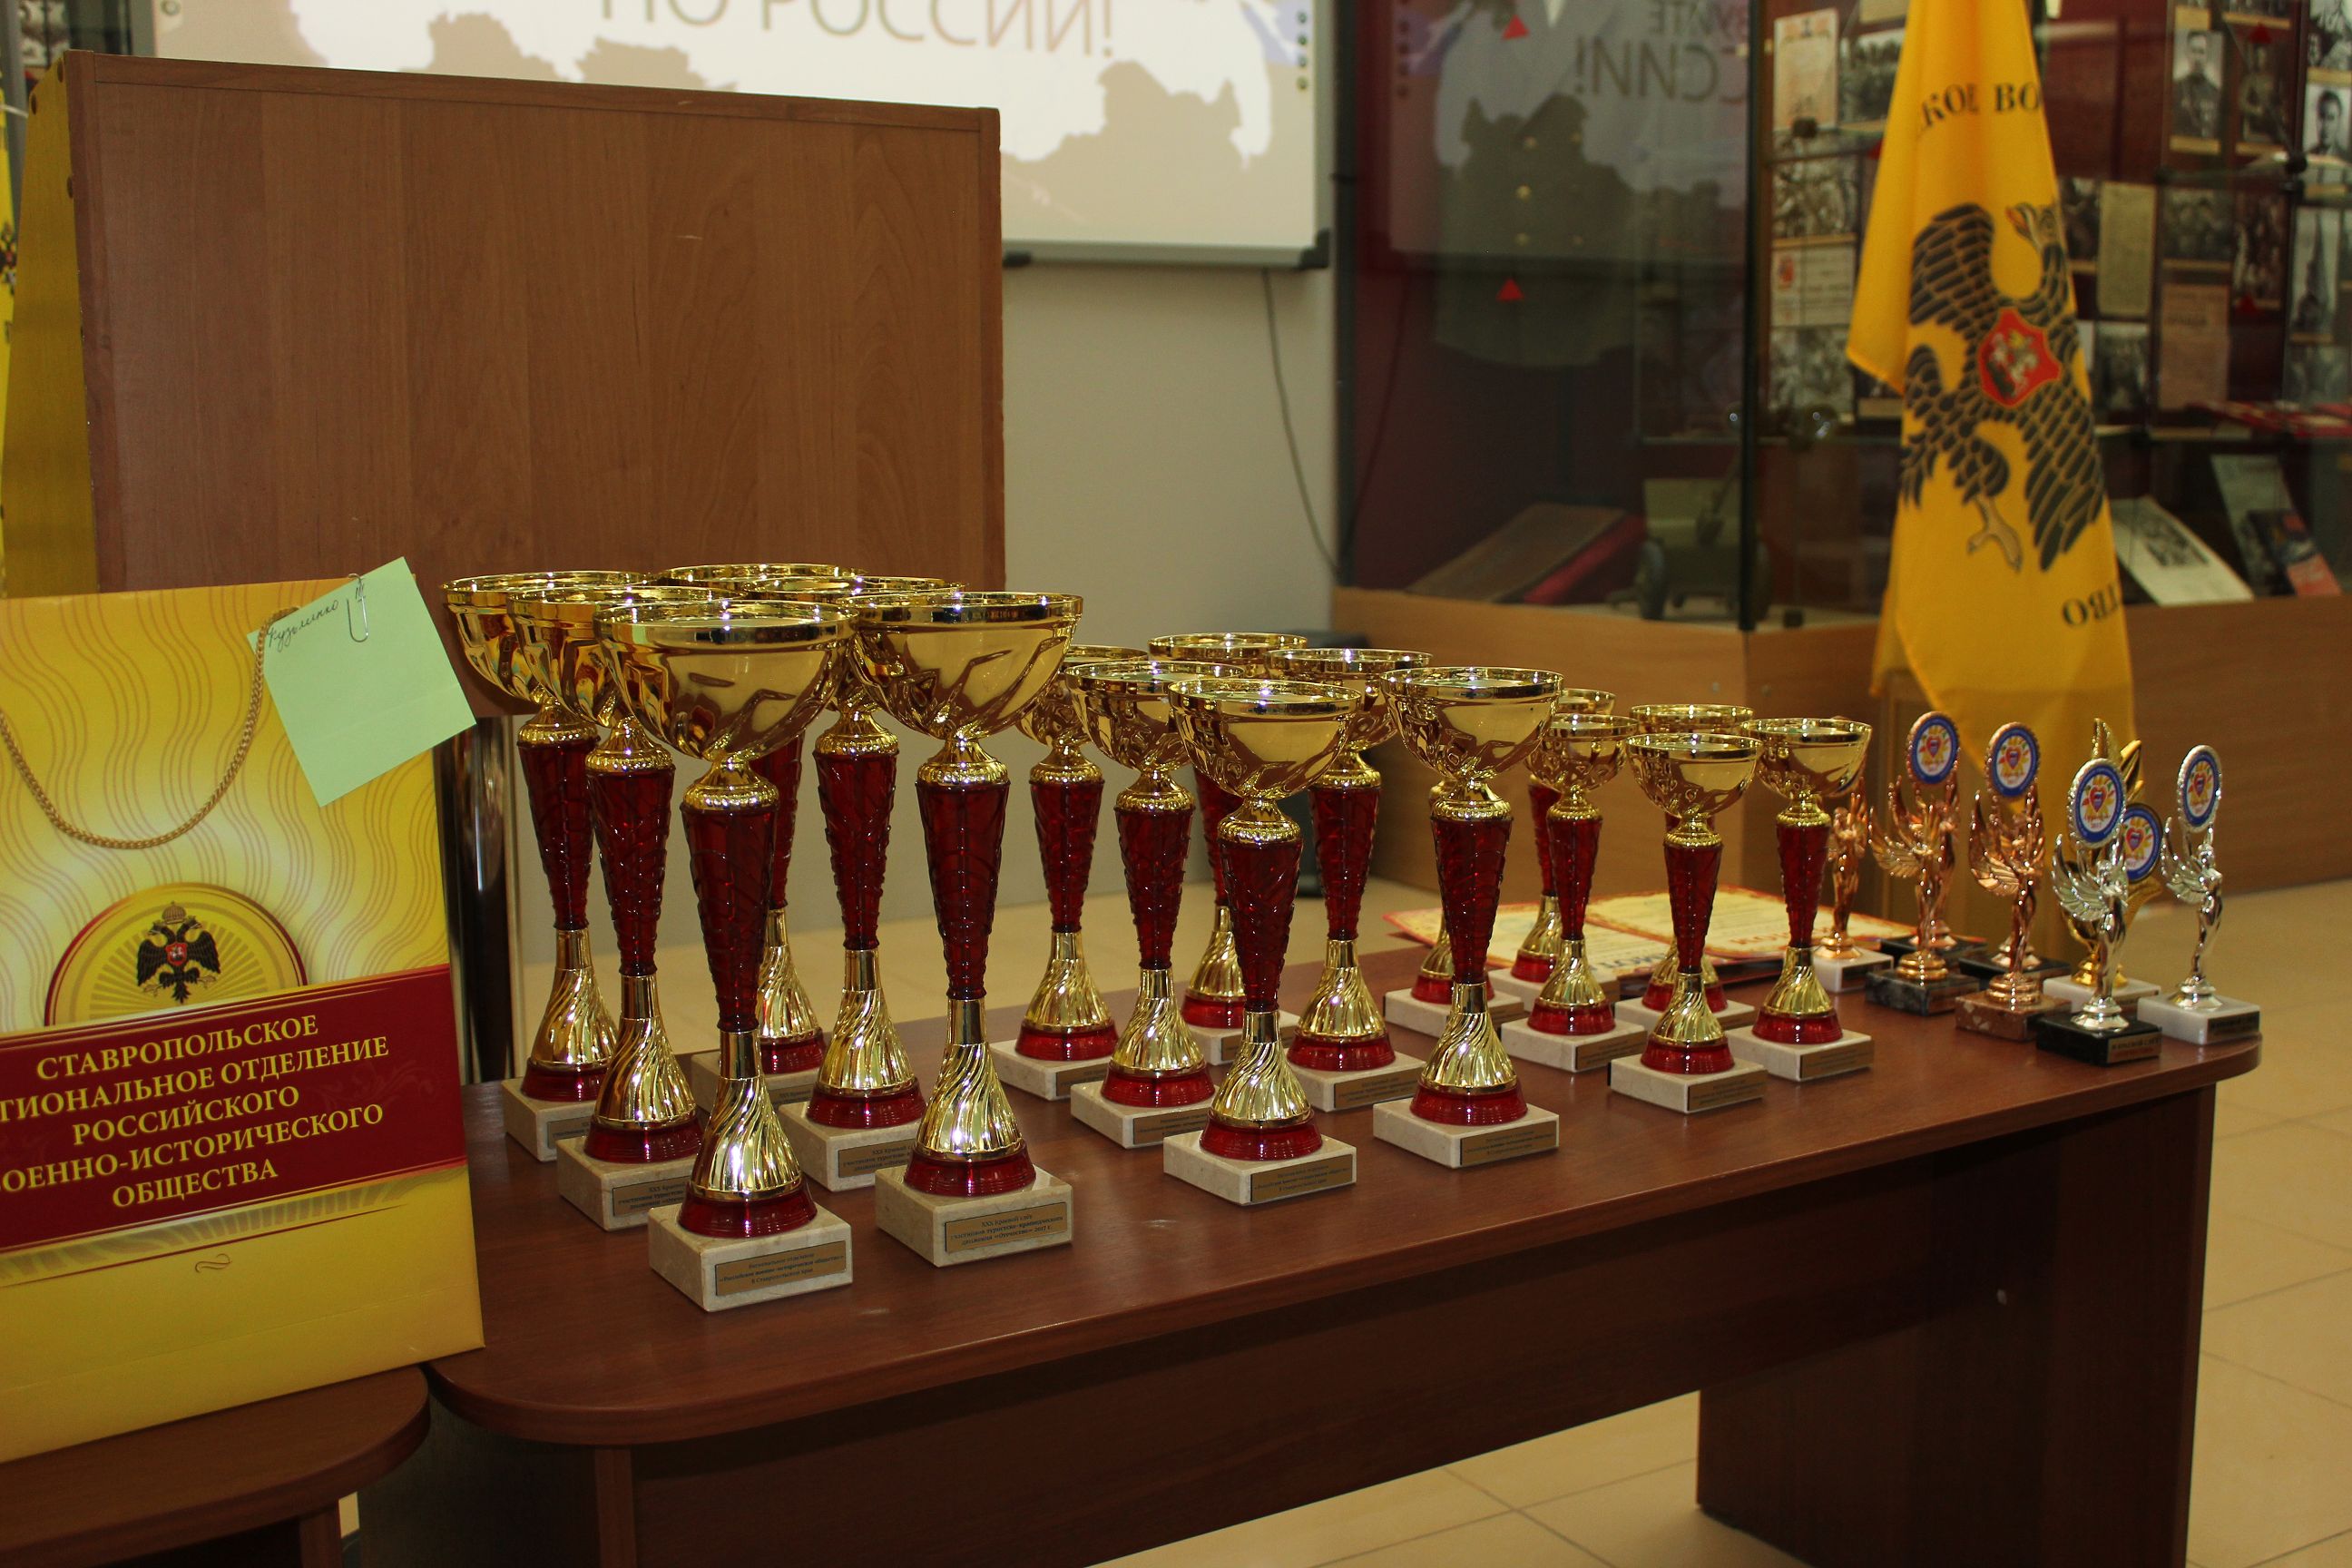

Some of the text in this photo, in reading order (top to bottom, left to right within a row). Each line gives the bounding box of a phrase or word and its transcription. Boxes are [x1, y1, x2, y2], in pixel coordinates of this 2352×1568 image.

[37, 1014, 318, 1080] СТАВРОПОЛЬСКОЕ
[221, 1036, 389, 1084] ОТДЕЛЕНИЕ
[73, 1086, 299, 1146] РОССИЙСКОГО
[0, 1103, 384, 1192] ОЕННО-ИСТОРИЧЕСКОГО
[113, 1158, 278, 1208] ОБЩЕСТВА
